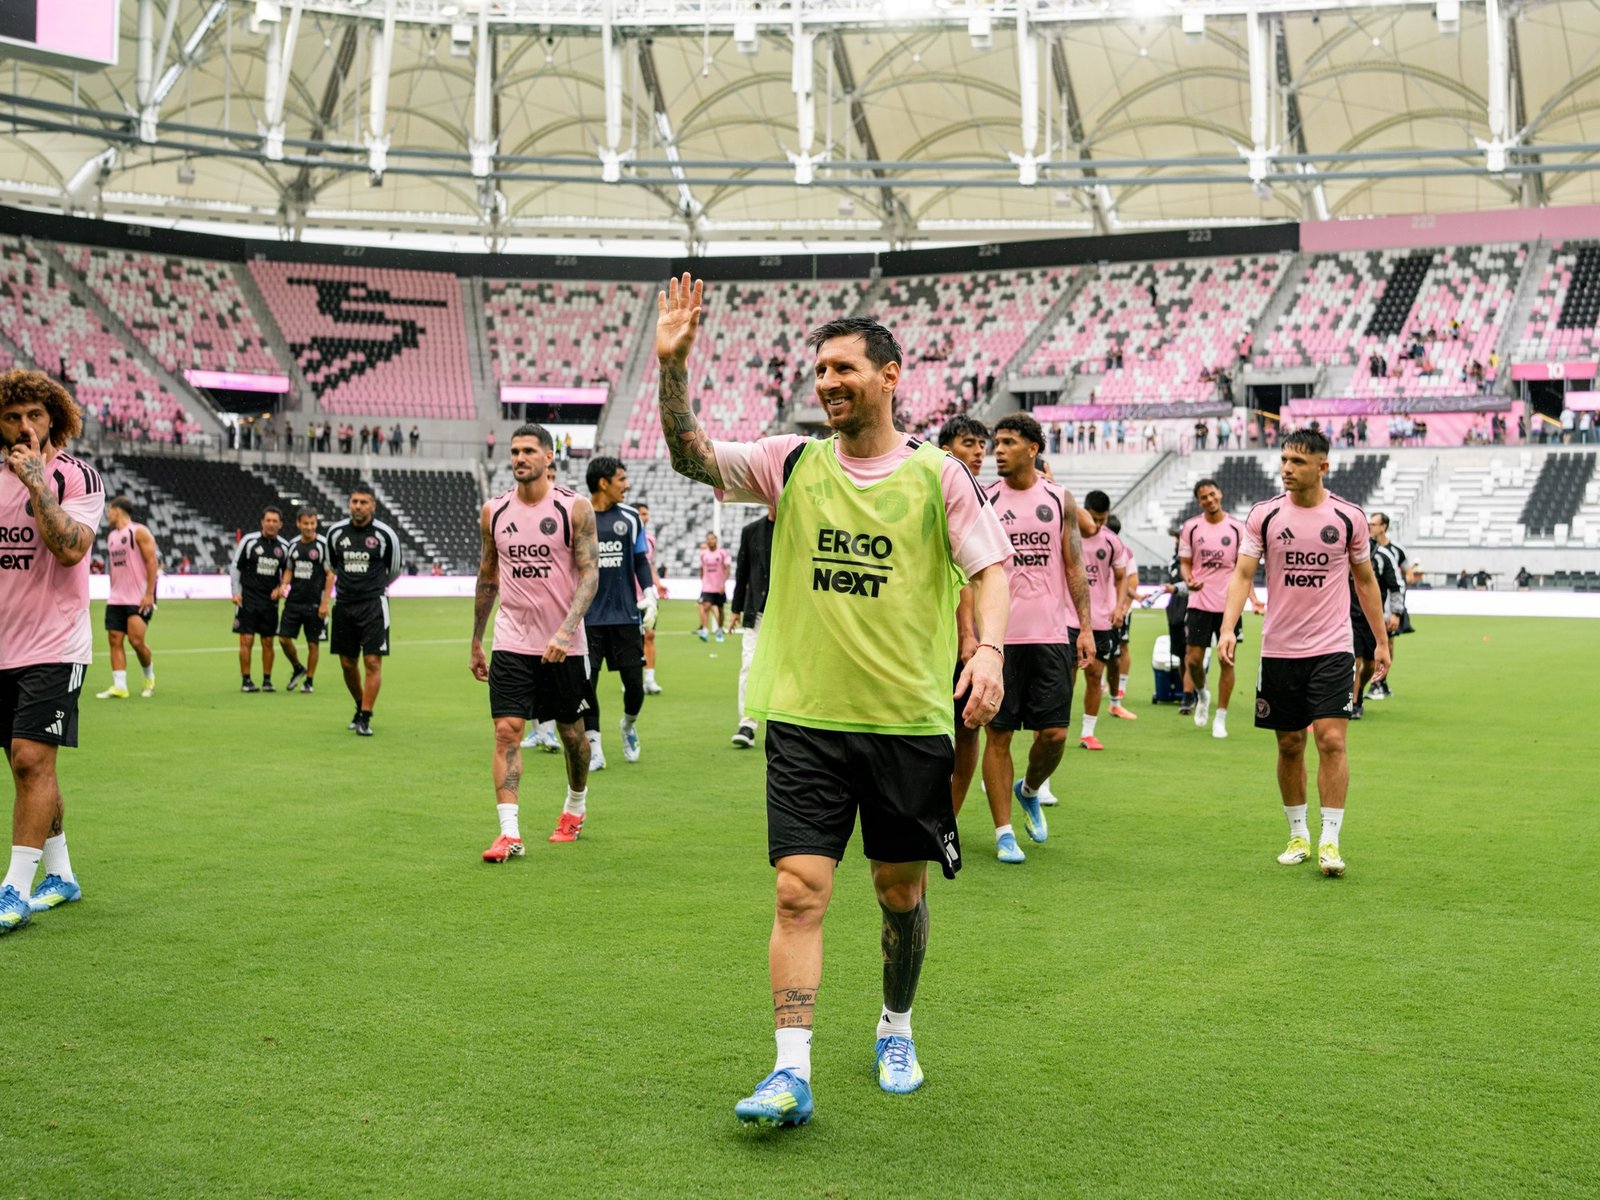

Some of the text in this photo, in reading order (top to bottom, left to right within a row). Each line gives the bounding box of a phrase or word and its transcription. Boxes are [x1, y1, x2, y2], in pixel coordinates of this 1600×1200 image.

[1546, 362, 1564, 379] 10
[0, 526, 34, 543] RGO
[1010, 532, 1050, 546] ERGO
[508, 544, 550, 557] ERGO
[598, 540, 623, 552] RGO
[817, 529, 893, 559] ERGO
[0, 554, 34, 570] eXT
[343, 551, 370, 560] ERGO
[1285, 551, 1329, 565] ERGO
[1086, 565, 1099, 573] GO
[55, 710, 65, 719] 37
[943, 831, 955, 843] 10
[785, 990, 812, 1005] Thiago
